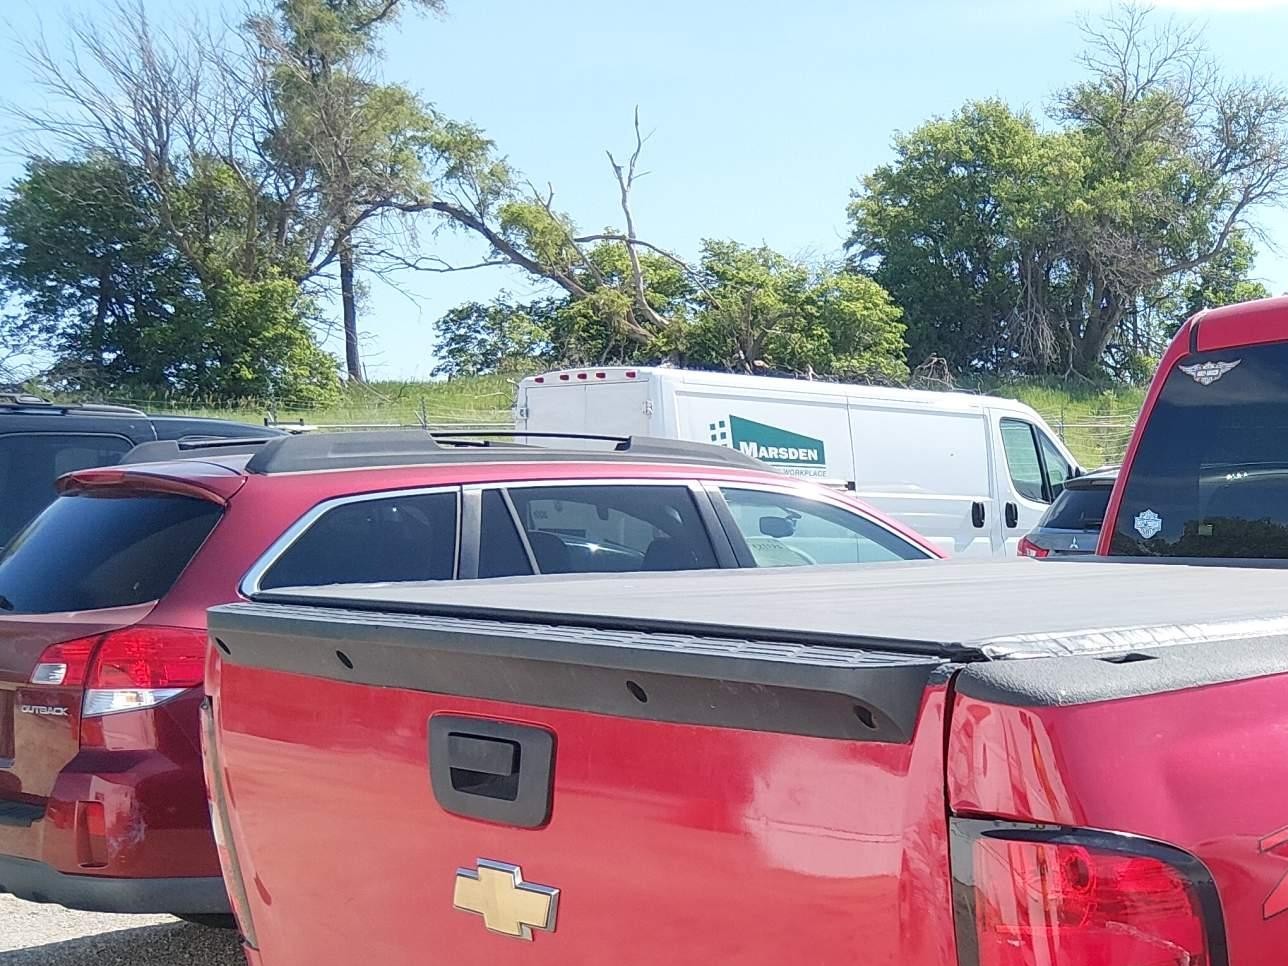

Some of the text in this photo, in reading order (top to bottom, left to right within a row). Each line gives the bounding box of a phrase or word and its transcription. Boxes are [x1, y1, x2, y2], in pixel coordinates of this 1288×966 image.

[739, 441, 818, 460] MARSDEN
[783, 468, 827, 477] WORKPLACE
[21, 704, 70, 716] OUTBACK
